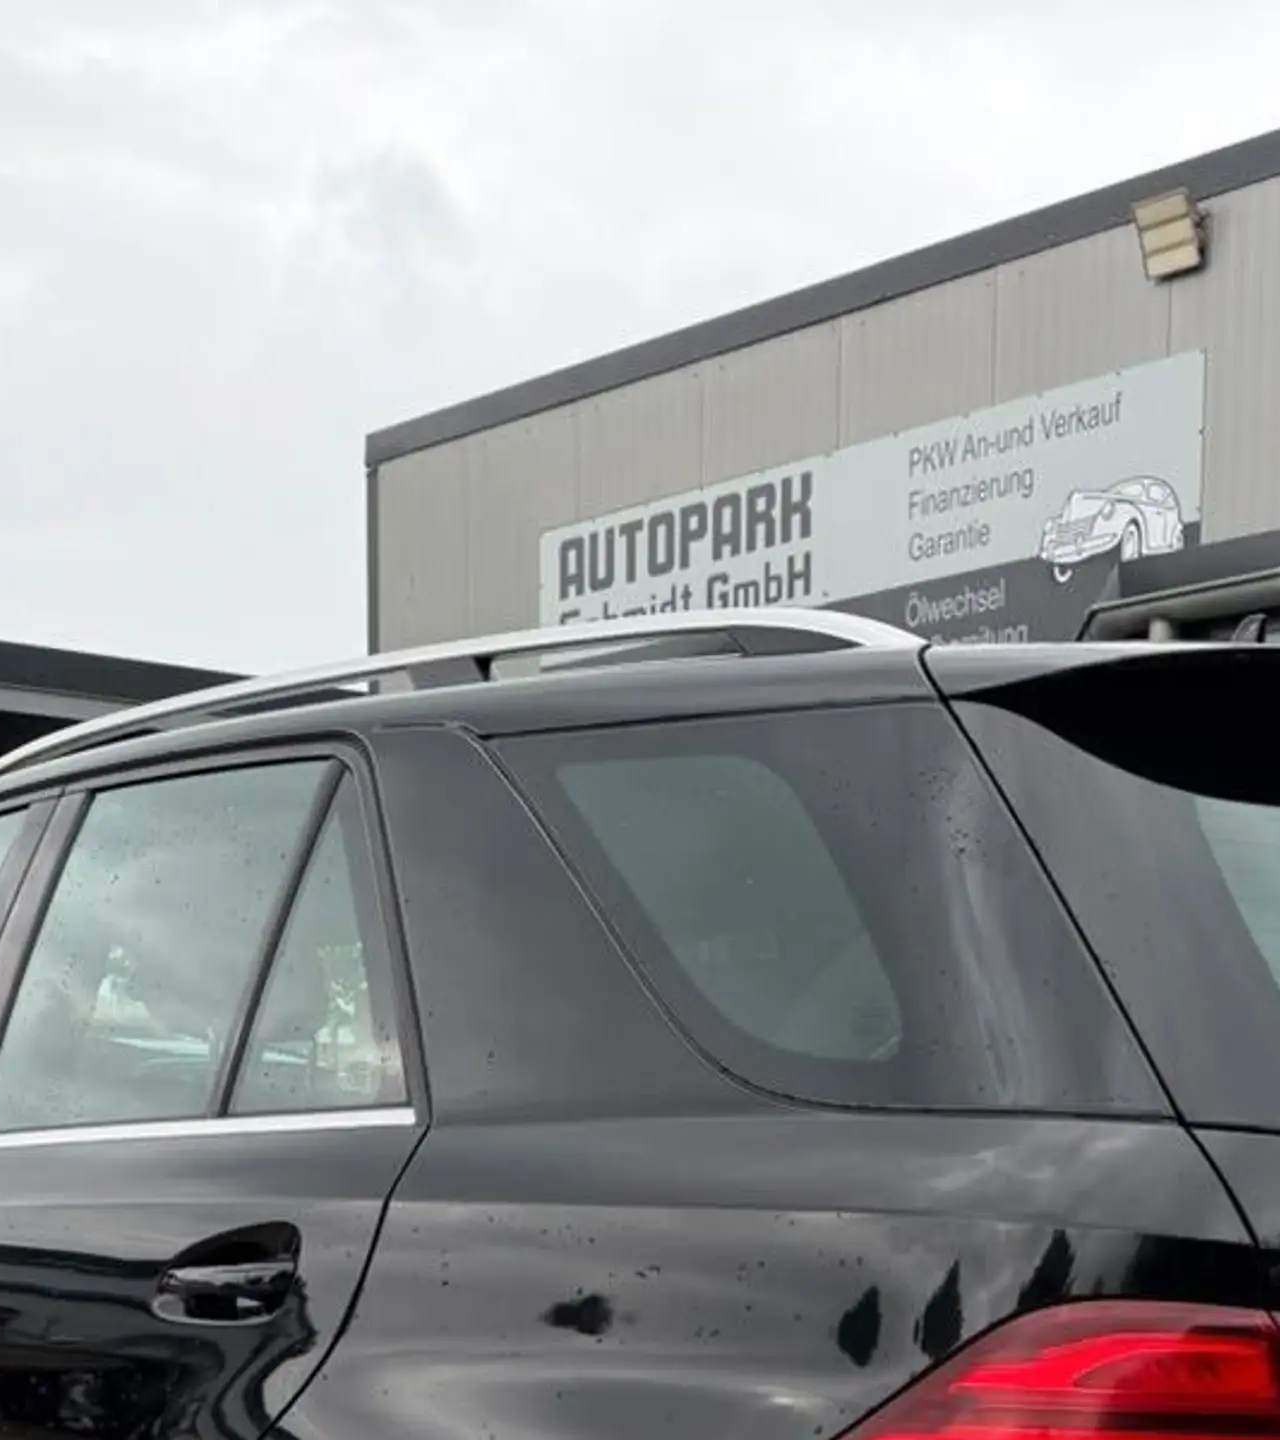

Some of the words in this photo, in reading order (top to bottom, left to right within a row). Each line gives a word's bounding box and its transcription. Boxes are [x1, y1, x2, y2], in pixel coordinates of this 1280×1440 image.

[909, 438, 958, 477] PKW
[961, 414, 1035, 462] An-und
[1039, 391, 1122, 440] Verkauf
[908, 466, 1035, 520] Finanzierung
[559, 471, 813, 600] AUTOPARK
[908, 520, 990, 562] Garantie
[706, 551, 812, 610] GmbH
[905, 578, 1006, 629] Ölwechsel
